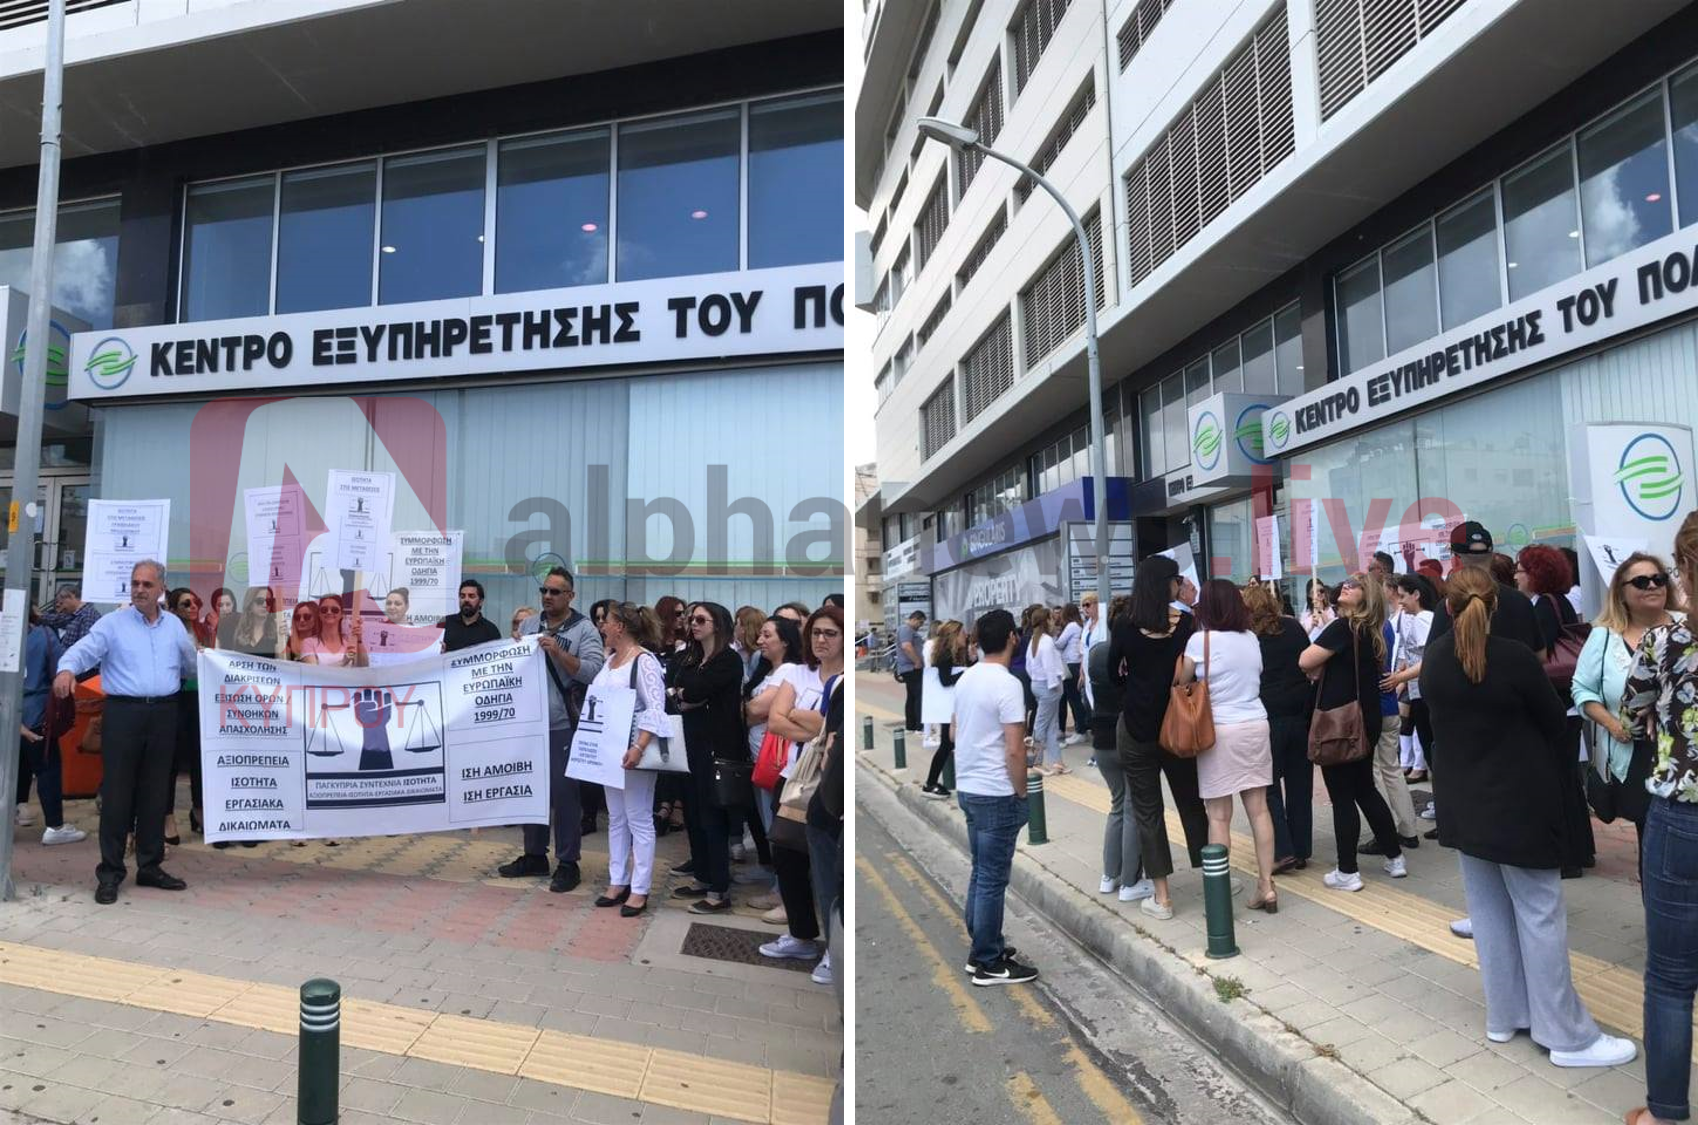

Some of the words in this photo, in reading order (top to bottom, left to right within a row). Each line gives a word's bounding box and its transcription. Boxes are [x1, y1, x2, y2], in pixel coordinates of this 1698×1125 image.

[150, 331, 293, 377] ΚΕΝΤΡΟ
[313, 301, 641, 366] ΕΞΥΠΗΡΕΤΗΣΗΣ
[668, 290, 763, 338] ΤΟΥ
[1295, 386, 1360, 435] ΚΕΝΤΡΟ
[1368, 309, 1546, 407] ΕΞΥΠΗΡΕΤΗΣΗΣ
[1557, 277, 1618, 333] ΤΟΥ
[1637, 244, 1698, 305] ΠΟ
[451, 645, 531, 667] ΣΥΜΜΟΡΦΩΣΗ
[229, 660, 254, 670] ΑΡΣΗ
[471, 667, 488, 677] ΜΕ
[491, 662, 513, 674] ΤΗΝ
[224, 673, 281, 685] ΔΙΑΚΡΙΣΕΩΝ
[463, 676, 523, 693] ΕΥΡΩΠΑΪΚΗ
[475, 693, 513, 706] ΟΔΗΓΙΑ
[227, 708, 279, 718] ΣΥΝΘΗΚΩΝ
[474, 707, 516, 722] 1999/70
[219, 725, 288, 735] ΑΠΑΣΧΟΛΗΣΗΣ
[217, 755, 290, 766] ΑΞΙΟΠΡΕΠΕΙΑ
[461, 766, 481, 779] ΙΣΗ
[484, 760, 533, 777] ΑΜΟΙΒΗ
[231, 777, 278, 787] ΙΣΟΤΗΤΑ
[403, 776, 437, 786] ΙΣΟΤΗΤΑ
[463, 789, 482, 802] ΙΣΗ
[486, 784, 533, 799] ΕΡΓΑΣΙΑ
[225, 799, 284, 810] ΕΡΓΑΣΙΑΚΑ
[219, 820, 291, 832] ΔΙΚΑΙΩΜΑΤΑ
